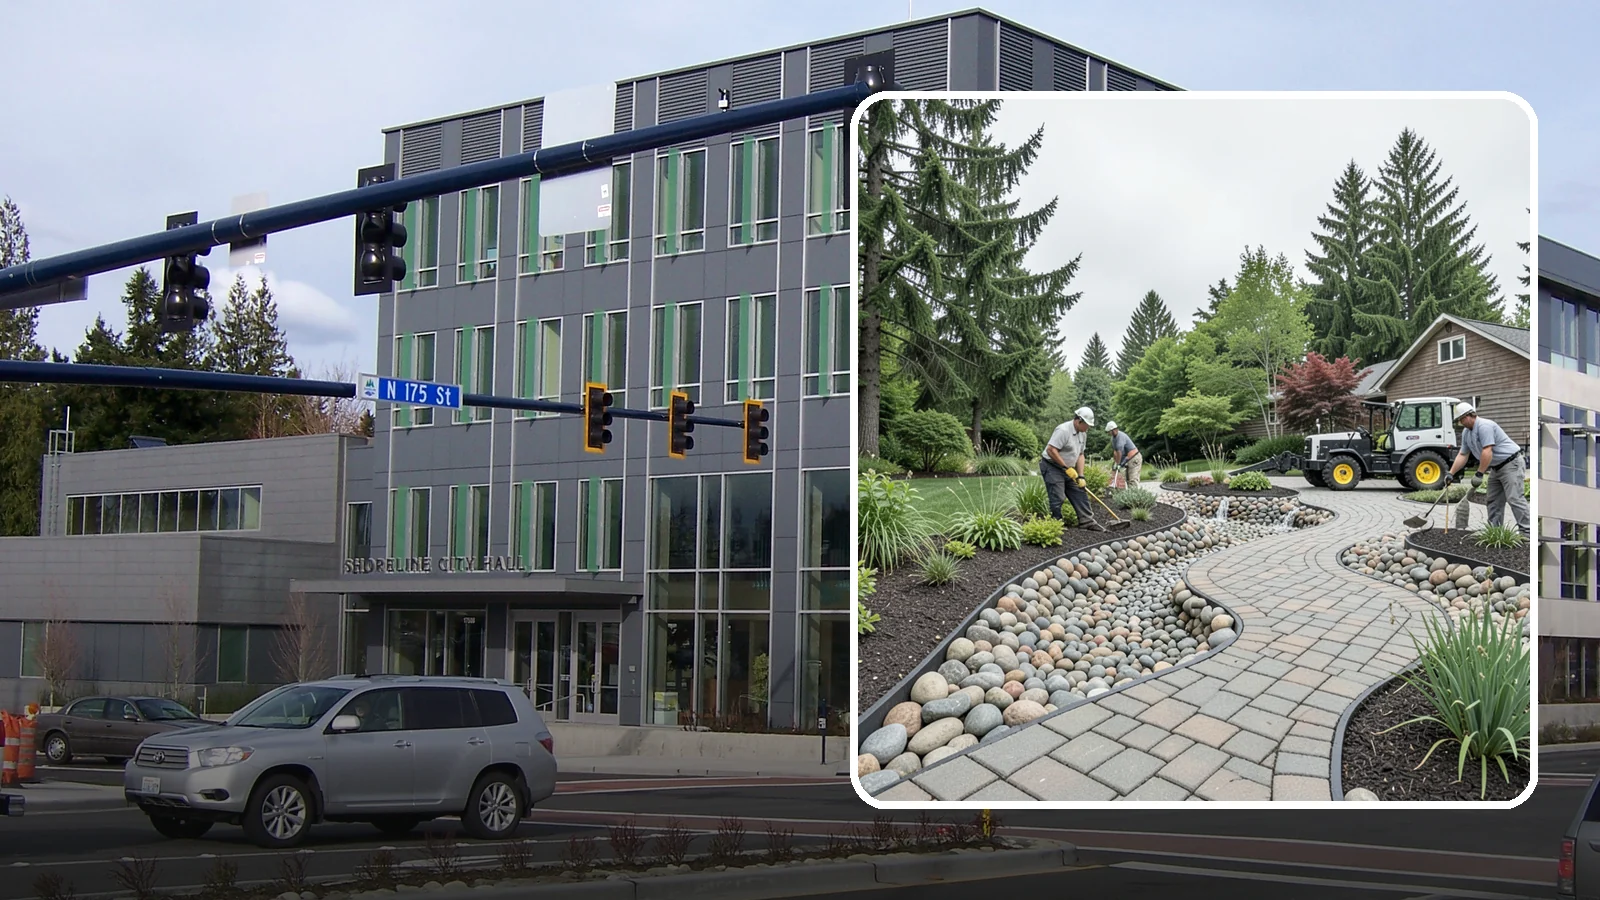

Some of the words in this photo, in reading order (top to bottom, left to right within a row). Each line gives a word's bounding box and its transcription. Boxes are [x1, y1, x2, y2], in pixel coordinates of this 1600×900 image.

[387, 381, 396, 399] N
[405, 382, 427, 403] 175
[436, 386, 451, 406] St
[344, 557, 431, 573] SHORELINE
[438, 556, 475, 572] CITY
[483, 556, 526, 571] HALL
